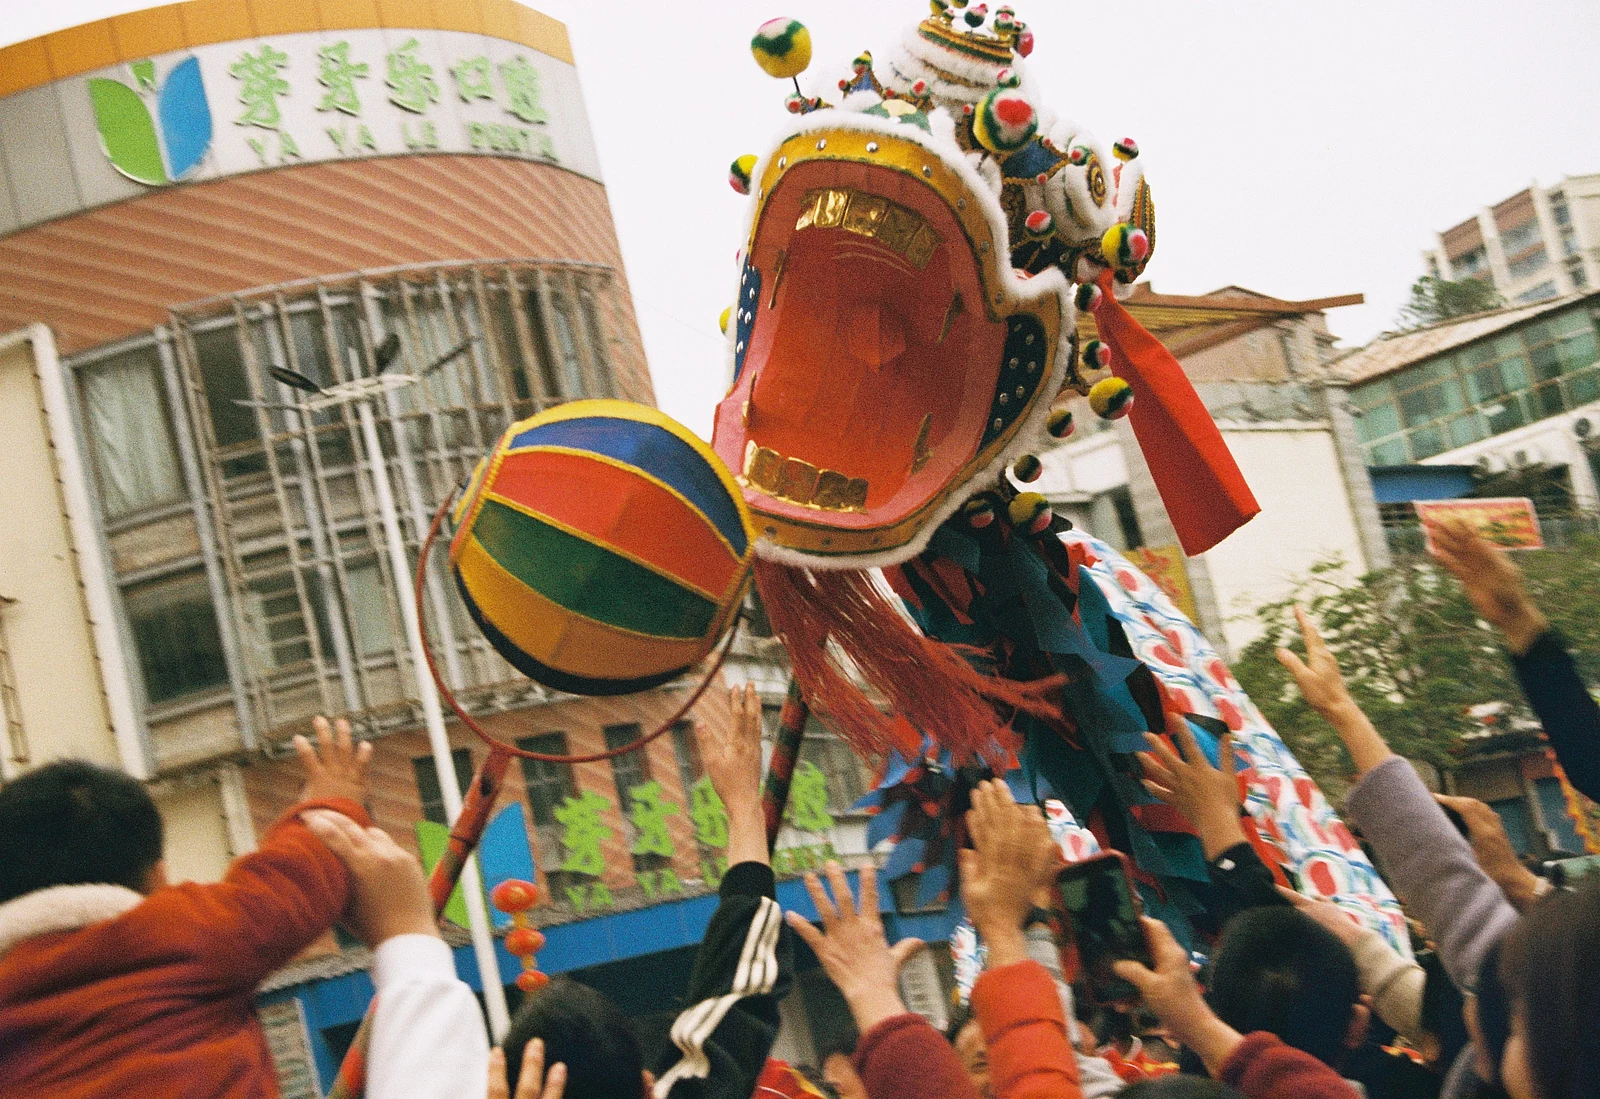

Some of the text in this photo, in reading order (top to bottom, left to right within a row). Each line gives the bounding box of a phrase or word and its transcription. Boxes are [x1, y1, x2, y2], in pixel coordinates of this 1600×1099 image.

[248, 132, 301, 166] YA
[326, 124, 377, 154] YA
[402, 120, 438, 149] LE
[554, 760, 835, 876] 芽牙乐腔
[565, 881, 614, 912] YA
[636, 867, 683, 898] YA
